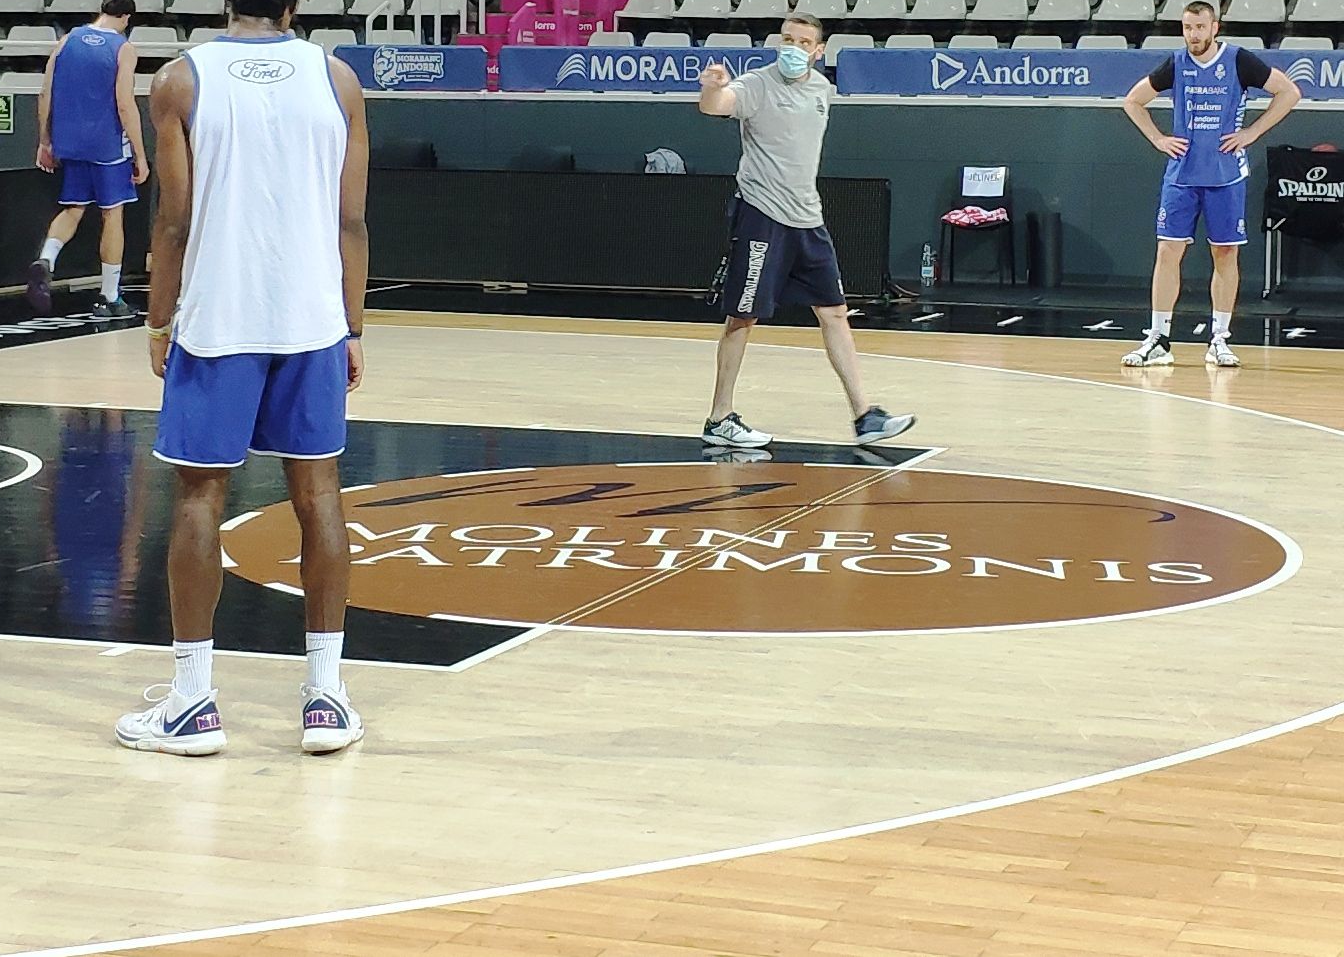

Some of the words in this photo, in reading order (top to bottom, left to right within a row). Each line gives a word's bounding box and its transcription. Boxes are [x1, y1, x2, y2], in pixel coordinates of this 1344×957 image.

[397, 63, 441, 73] ANDORRA
[967, 56, 1091, 87] Andorra
[737, 240, 769, 314] SPALDING
[346, 522, 952, 553] MOLINES
